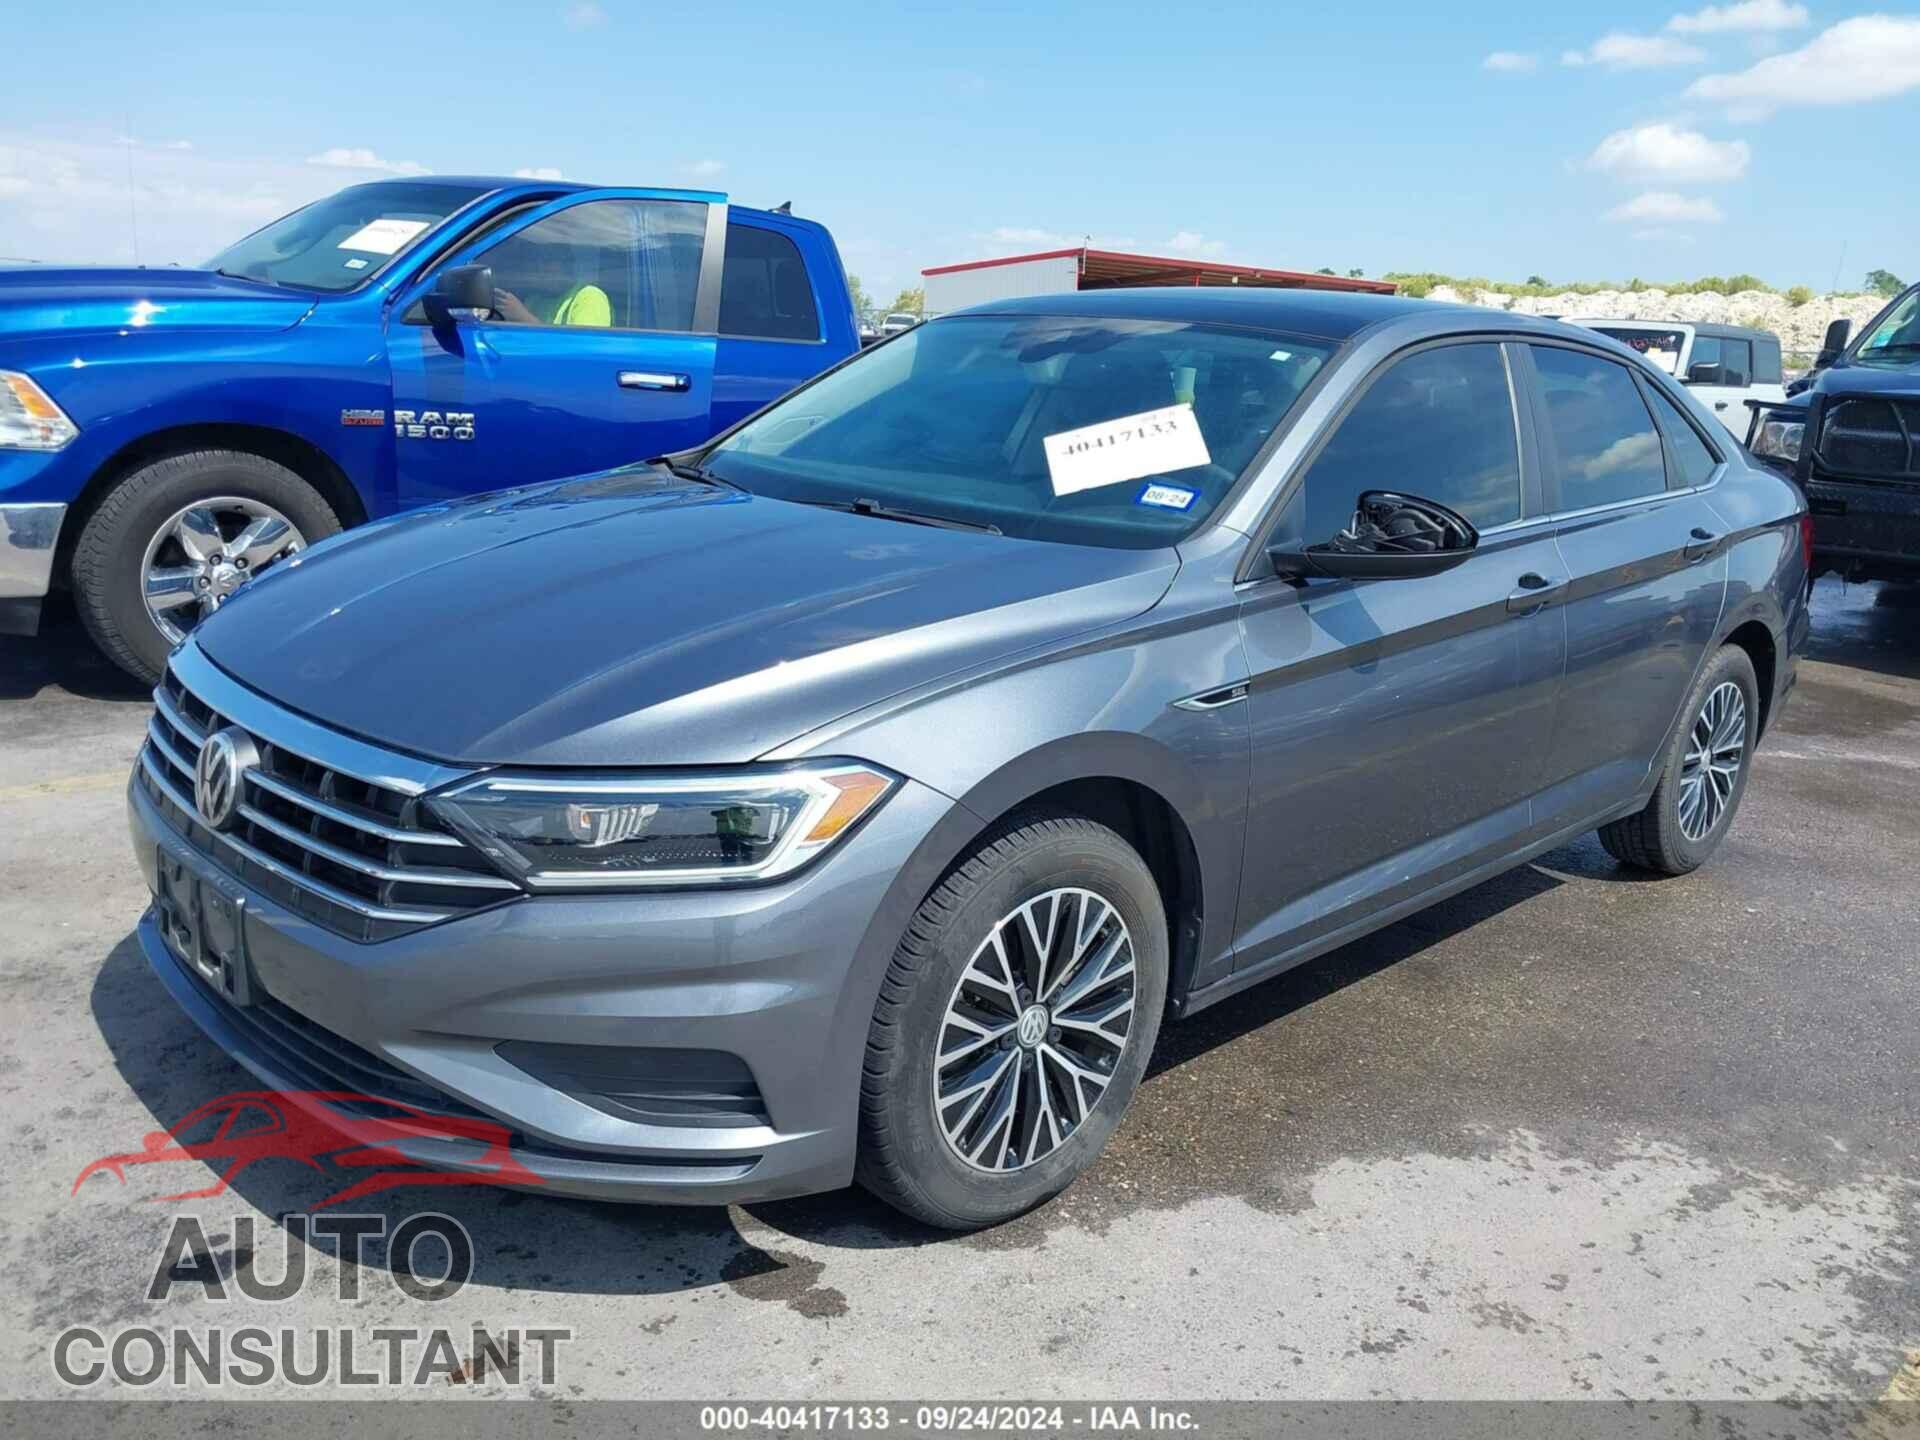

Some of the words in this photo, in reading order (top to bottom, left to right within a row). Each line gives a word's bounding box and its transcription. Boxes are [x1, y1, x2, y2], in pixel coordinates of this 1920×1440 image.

[394, 410, 475, 425] RAM
[394, 424, 476, 440] 1500
[1061, 420, 1178, 455] 40417133
